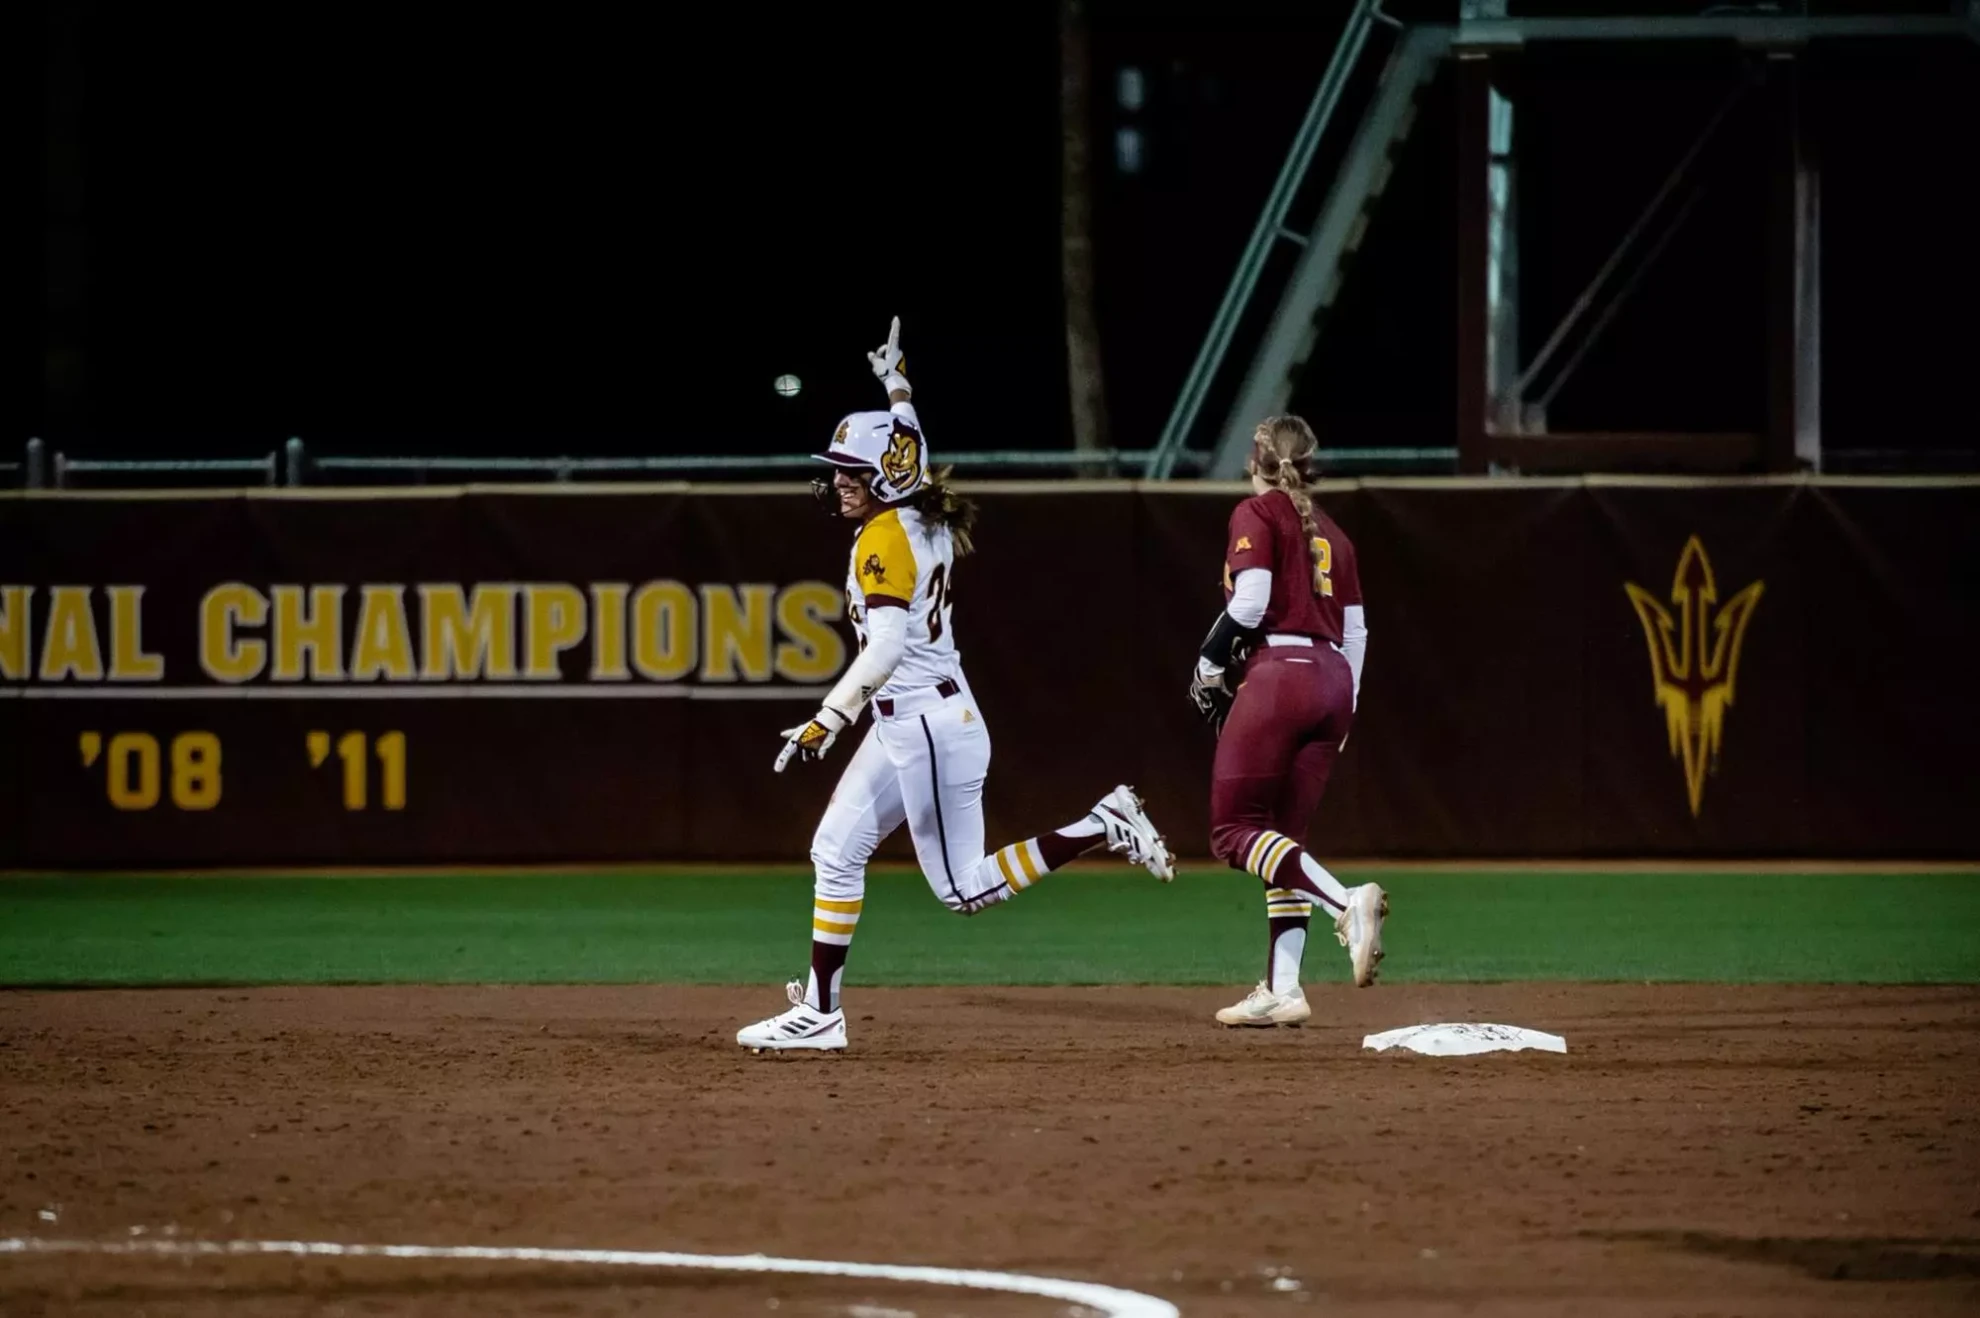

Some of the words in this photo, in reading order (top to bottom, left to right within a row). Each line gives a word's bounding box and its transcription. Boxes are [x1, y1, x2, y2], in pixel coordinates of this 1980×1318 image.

[926, 562, 952, 644] 2
[1310, 536, 1333, 597] 2
[199, 581, 847, 683] CHAMPIONS
